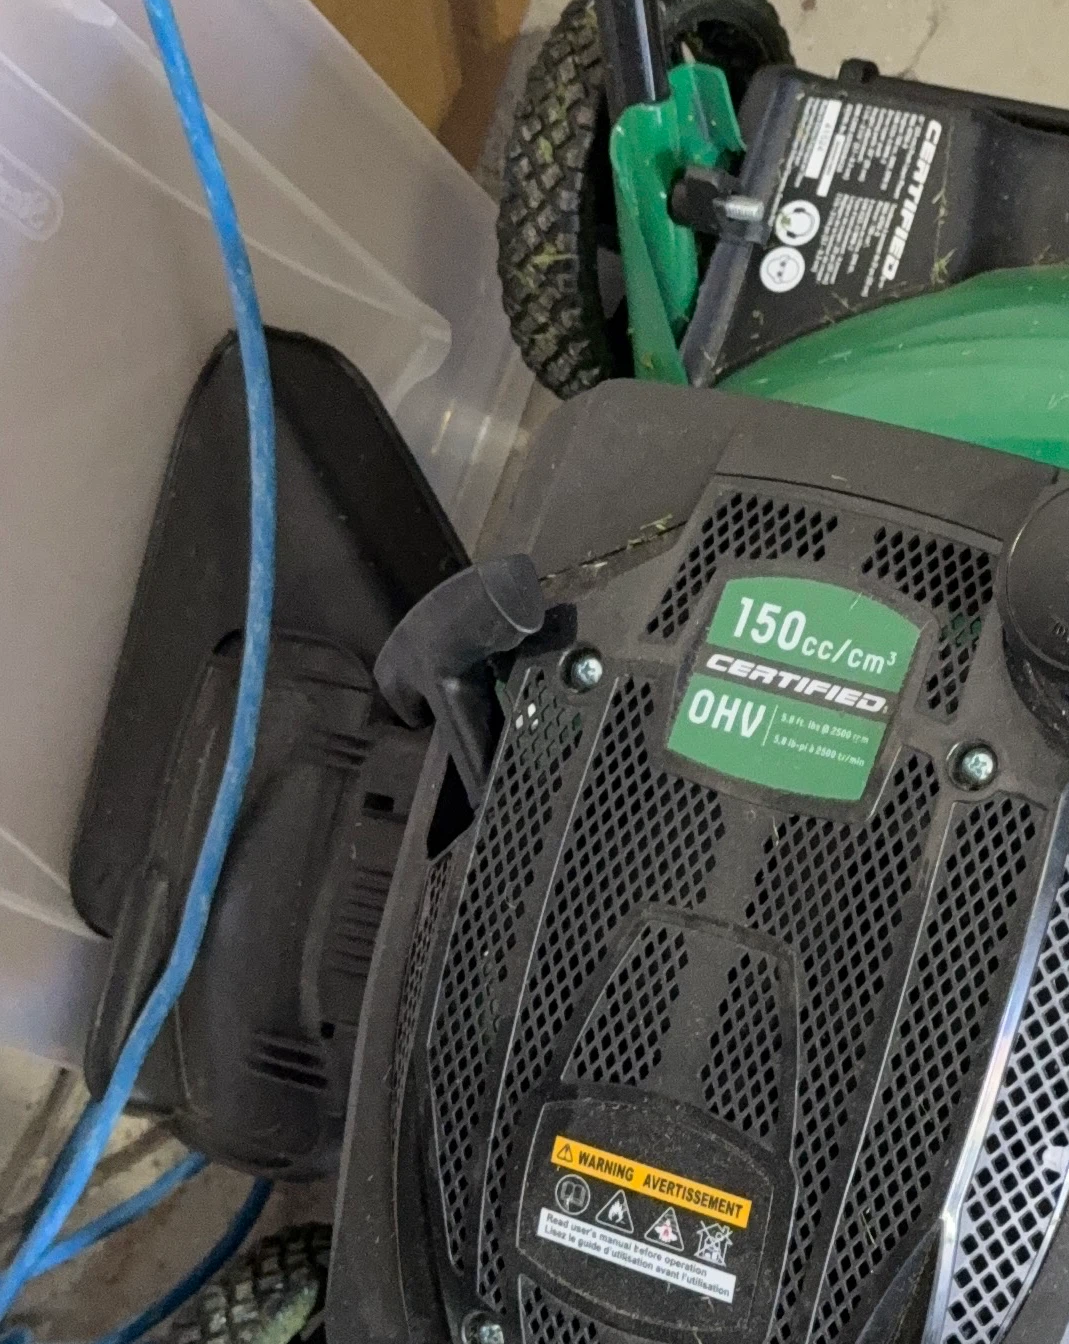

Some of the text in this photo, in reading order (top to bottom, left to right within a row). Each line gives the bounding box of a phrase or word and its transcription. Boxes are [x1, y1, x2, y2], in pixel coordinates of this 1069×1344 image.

[881, 119, 942, 281] CERTIFIED
[688, 688, 767, 739] OHV
[706, 654, 887, 713] CERTIFIED
[815, 744, 837, 759] 2500
[830, 726, 852, 740] 2500
[577, 1150, 744, 1219] WARNING AVERTISSEMENT
[544, 1224, 567, 1240] Lisez
[568, 1232, 576, 1243] le
[577, 1238, 602, 1252] guide
[655, 1264, 680, 1280] avant
[681, 1272, 730, 1297] l'utilisation
[546, 1212, 708, 1277] Read user's manual before operation
